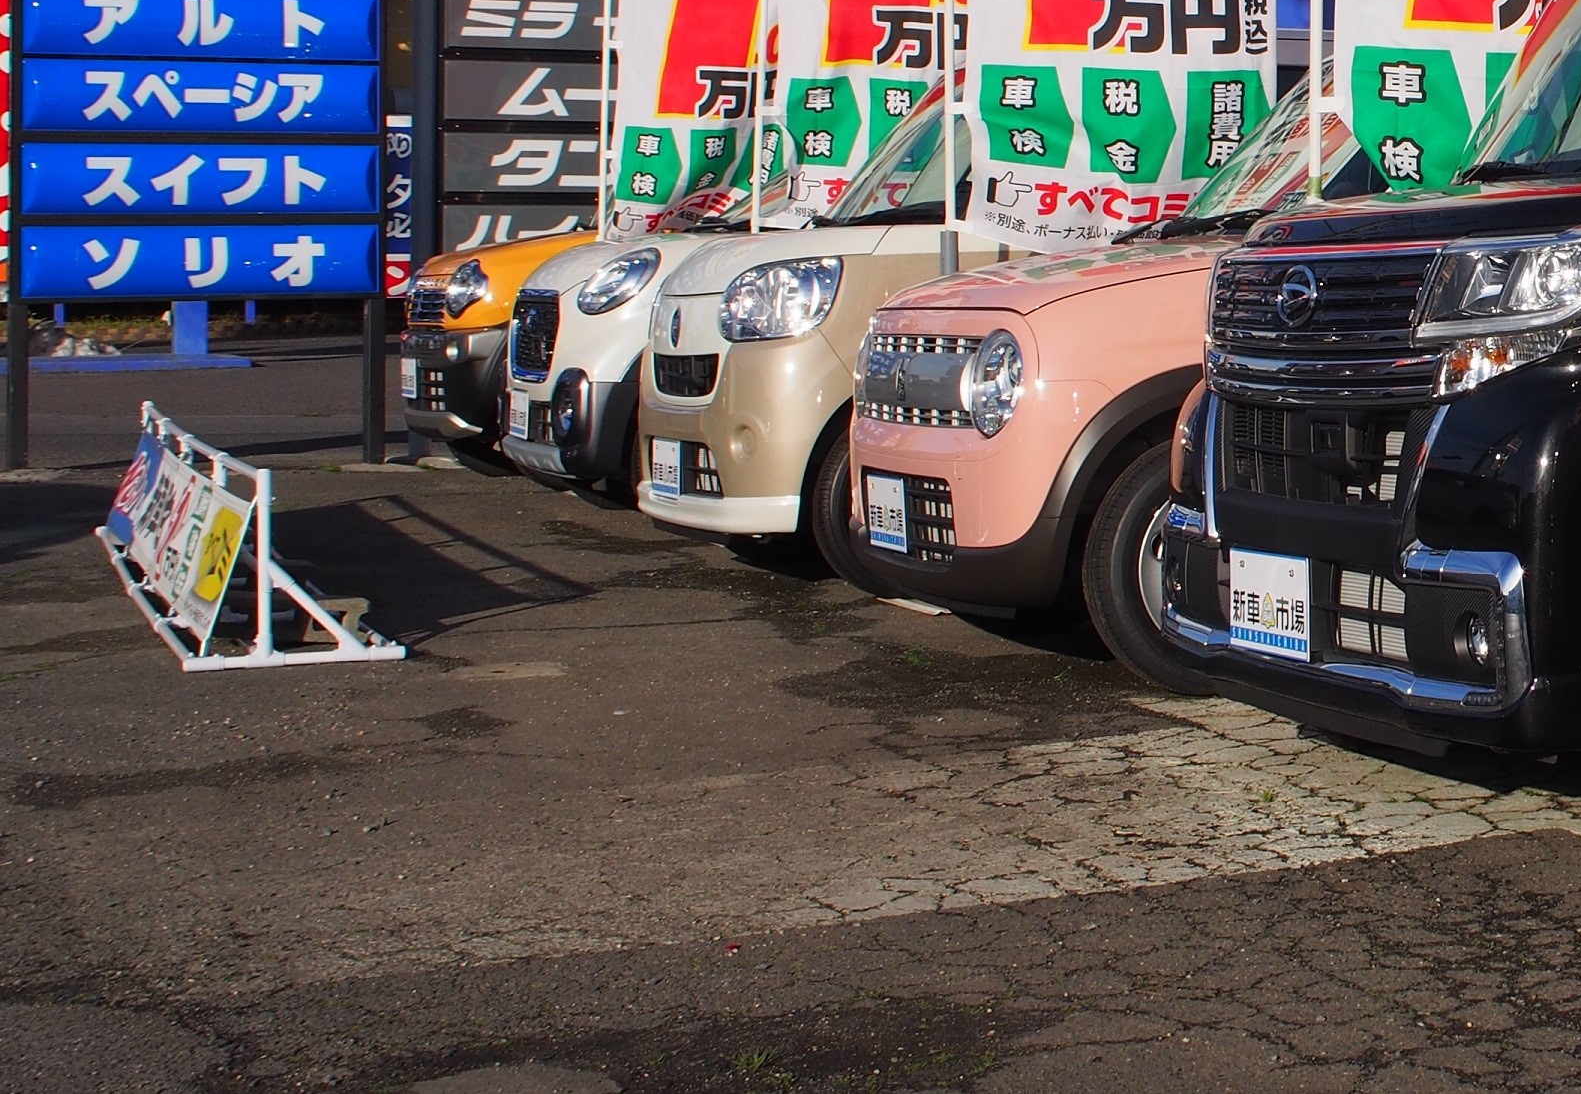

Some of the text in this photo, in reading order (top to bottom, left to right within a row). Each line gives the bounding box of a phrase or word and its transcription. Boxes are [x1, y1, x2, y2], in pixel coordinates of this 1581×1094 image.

[83, 70, 324, 123] スペーシア
[804, 87, 834, 158] 車検
[1000, 76, 1047, 156] 車検
[1379, 60, 1426, 184] 車検
[1103, 77, 1141, 175] 税金
[82, 154, 327, 207] スイフト
[631, 134, 661, 197] 車検
[697, 136, 726, 189] 税金
[82, 236, 326, 290] ソリオ
[1232, 588, 1260, 625] 新車
[1275, 597, 1305, 635] 市場
